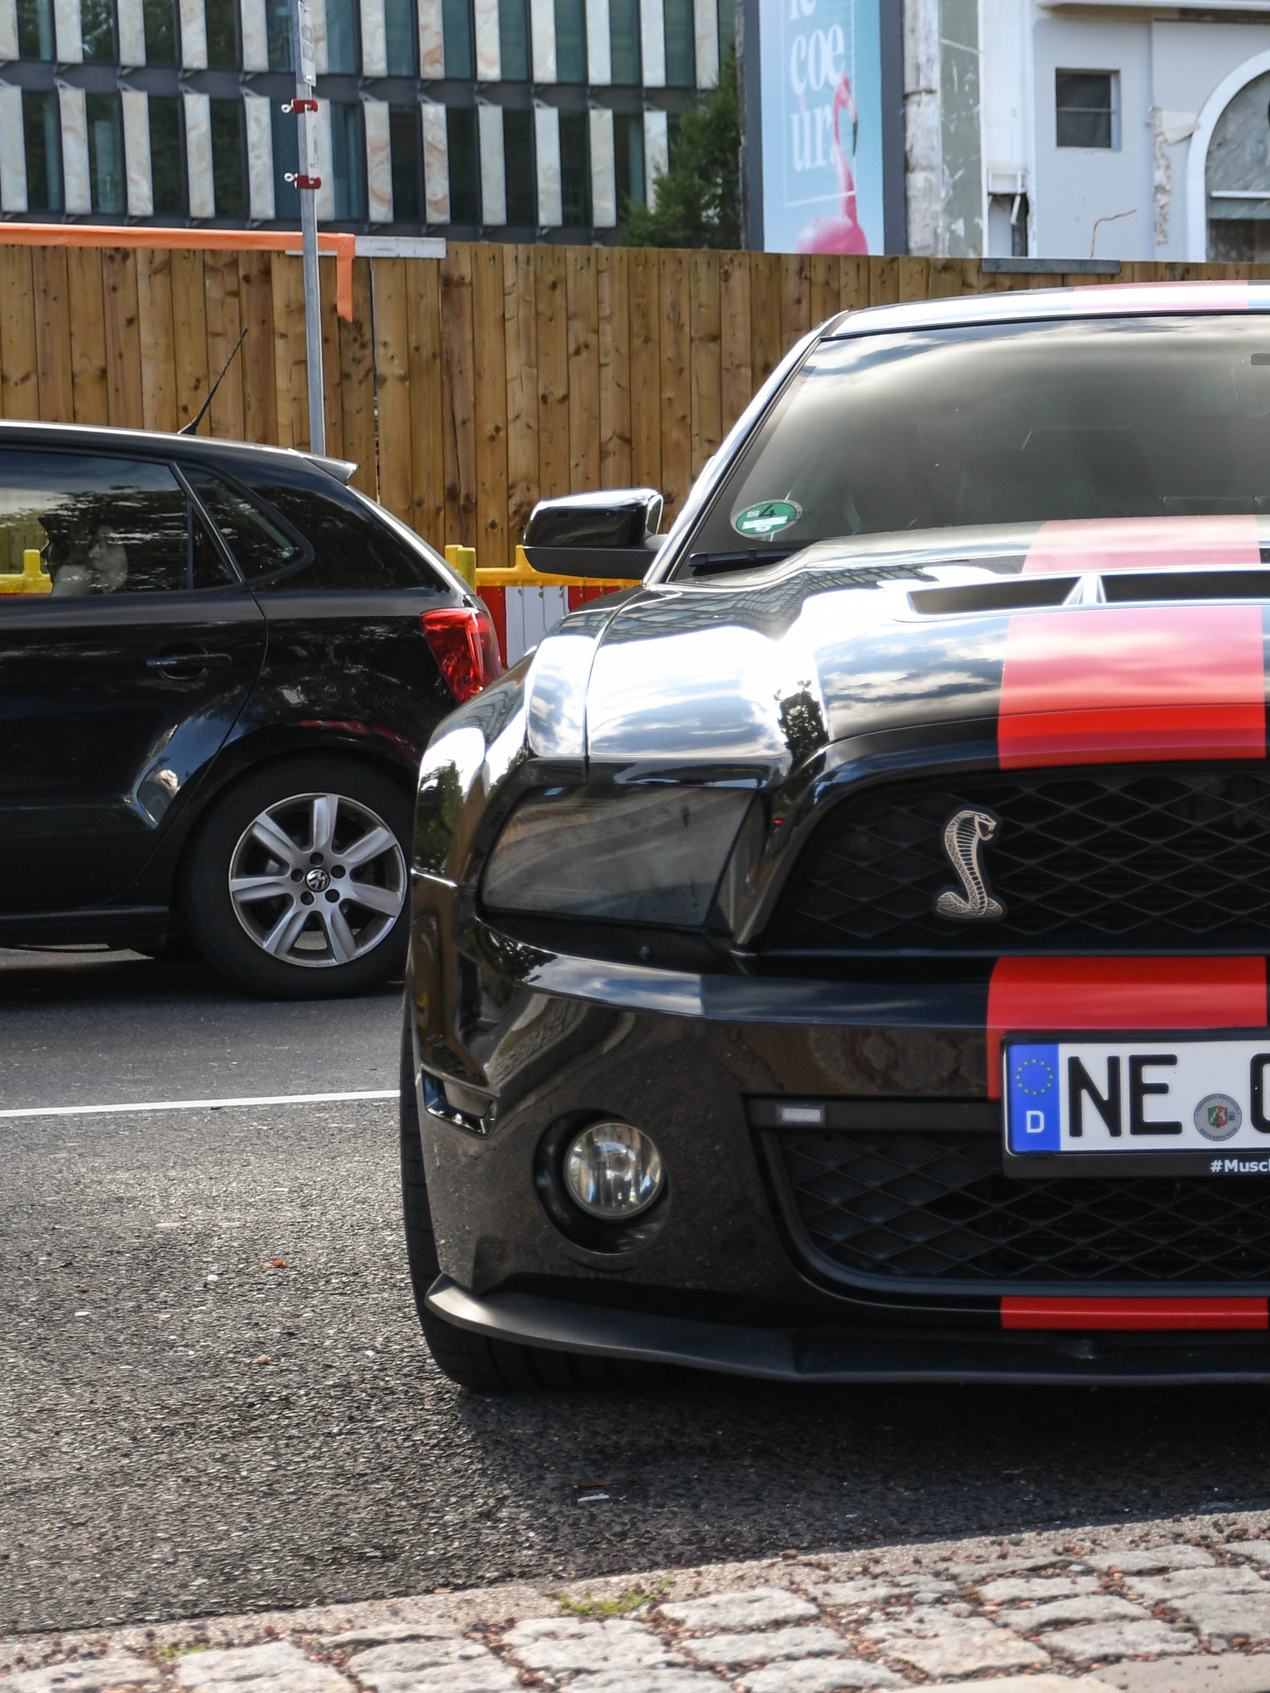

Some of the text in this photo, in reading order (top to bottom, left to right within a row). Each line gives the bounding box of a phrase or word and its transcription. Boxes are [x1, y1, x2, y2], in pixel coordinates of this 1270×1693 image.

[789, 23, 846, 97] coe
[759, 504, 775, 517] 4
[1067, 1053, 1183, 1138] NE
[1025, 1110, 1045, 1134] D
